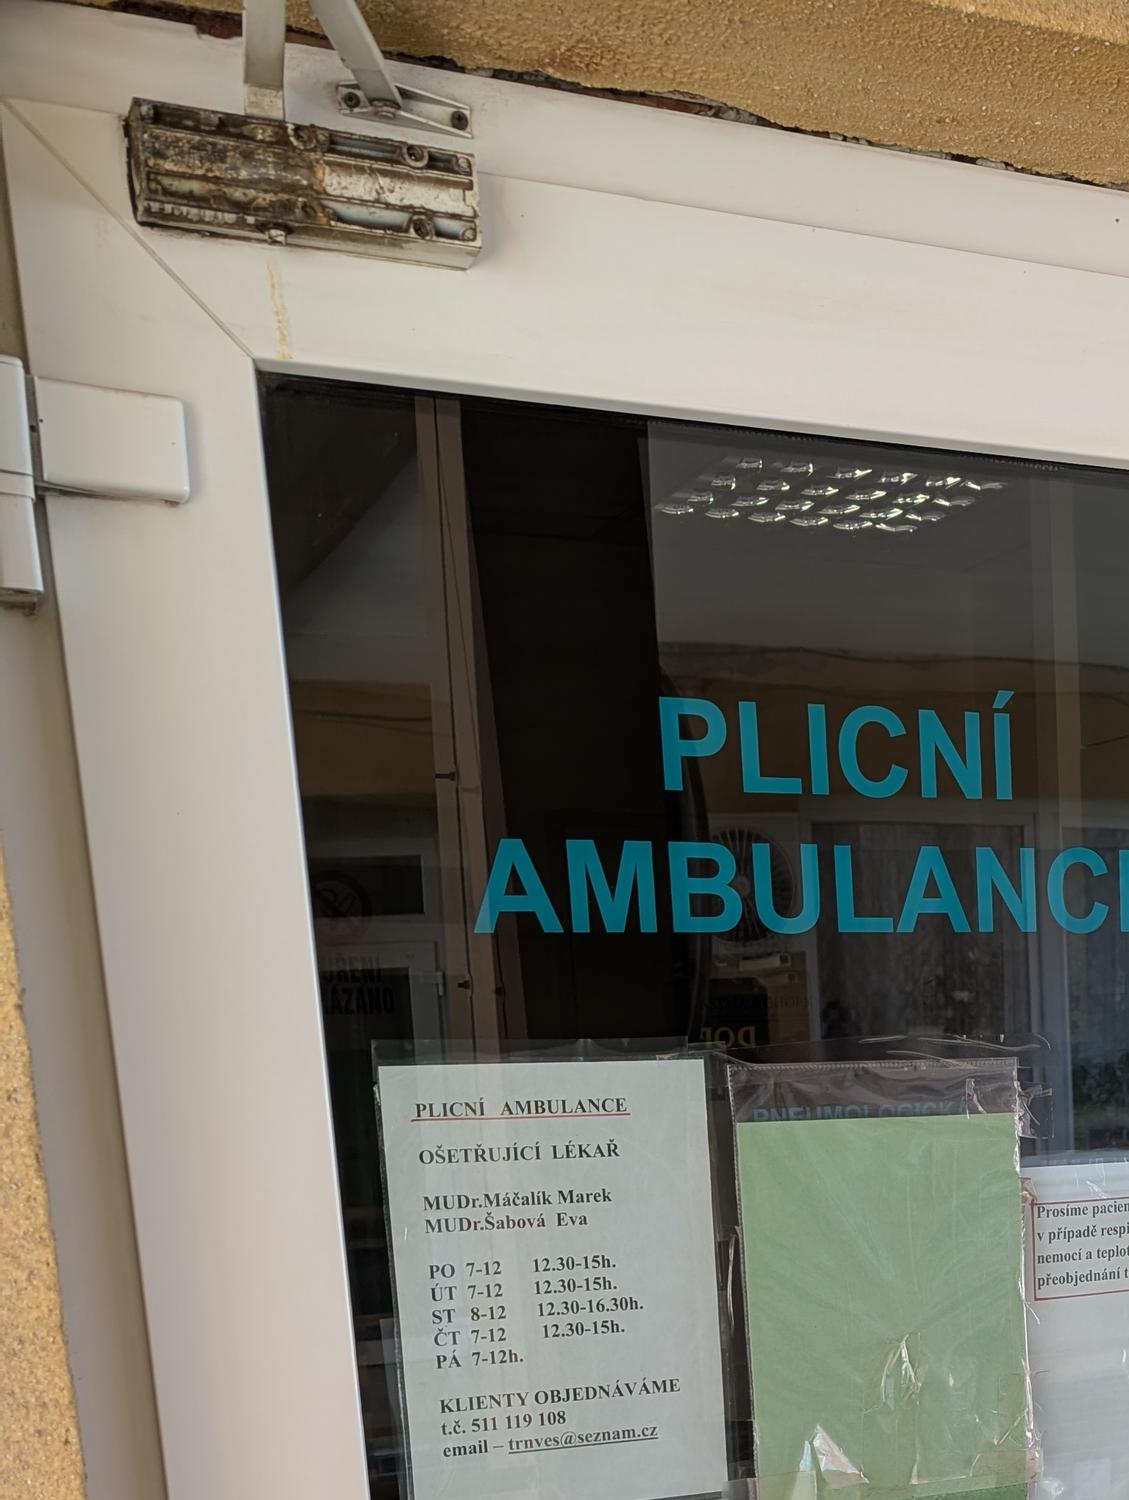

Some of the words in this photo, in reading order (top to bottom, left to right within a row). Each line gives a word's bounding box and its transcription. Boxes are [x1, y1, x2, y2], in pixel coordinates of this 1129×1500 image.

[659, 690, 1013, 800] PLICNÍ
[415, 1097, 485, 1118] PLICNÍ
[500, 1098, 627, 1116] AMBULANCE
[419, 1141, 541, 1165] OŠETŘUJÍCÍ
[551, 1139, 620, 1161] LÉKAŘ
[423, 1190, 552, 1211] MUDr.Máčalík
[557, 1188, 612, 1205] Marek
[1036, 1202, 1089, 1219] Prosíme
[424, 1211, 546, 1234] MUDr.Šabová
[556, 1213, 588, 1228] Eva
[1037, 1232, 1044, 1242] v
[1048, 1225, 1097, 1244] případě
[429, 1264, 455, 1280] PO
[465, 1261, 502, 1277] 7-12
[532, 1255, 617, 1273] 12.30-15h.
[1037, 1248, 1082, 1265] nemocí
[1085, 1250, 1093, 1260] a
[431, 1283, 457, 1302] ÚT
[467, 1284, 504, 1300] 7-12
[534, 1277, 618, 1295] 12.30-15h.
[1037, 1268, 1121, 1290] přeobjednání
[431, 1309, 455, 1325] ST
[470, 1305, 507, 1322] 8-12
[537, 1297, 644, 1317] 12.30-16.30h.
[434, 1326, 460, 1347] ČT
[471, 1328, 507, 1345] 7-12
[542, 1321, 625, 1339] 12.30-15h.
[436, 1350, 462, 1369] PÁ
[471, 1350, 524, 1367] 7-12h.
[440, 1391, 529, 1414] KLIENTY
[534, 1377, 681, 1405] OBJEDNÁVÁME
[441, 1420, 467, 1436] t.č.
[471, 1418, 497, 1434] 511
[506, 1414, 533, 1431] 119
[538, 1410, 567, 1427] 108
[443, 1440, 489, 1458] email
[508, 1425, 658, 1453] trnves@seznam.cz
